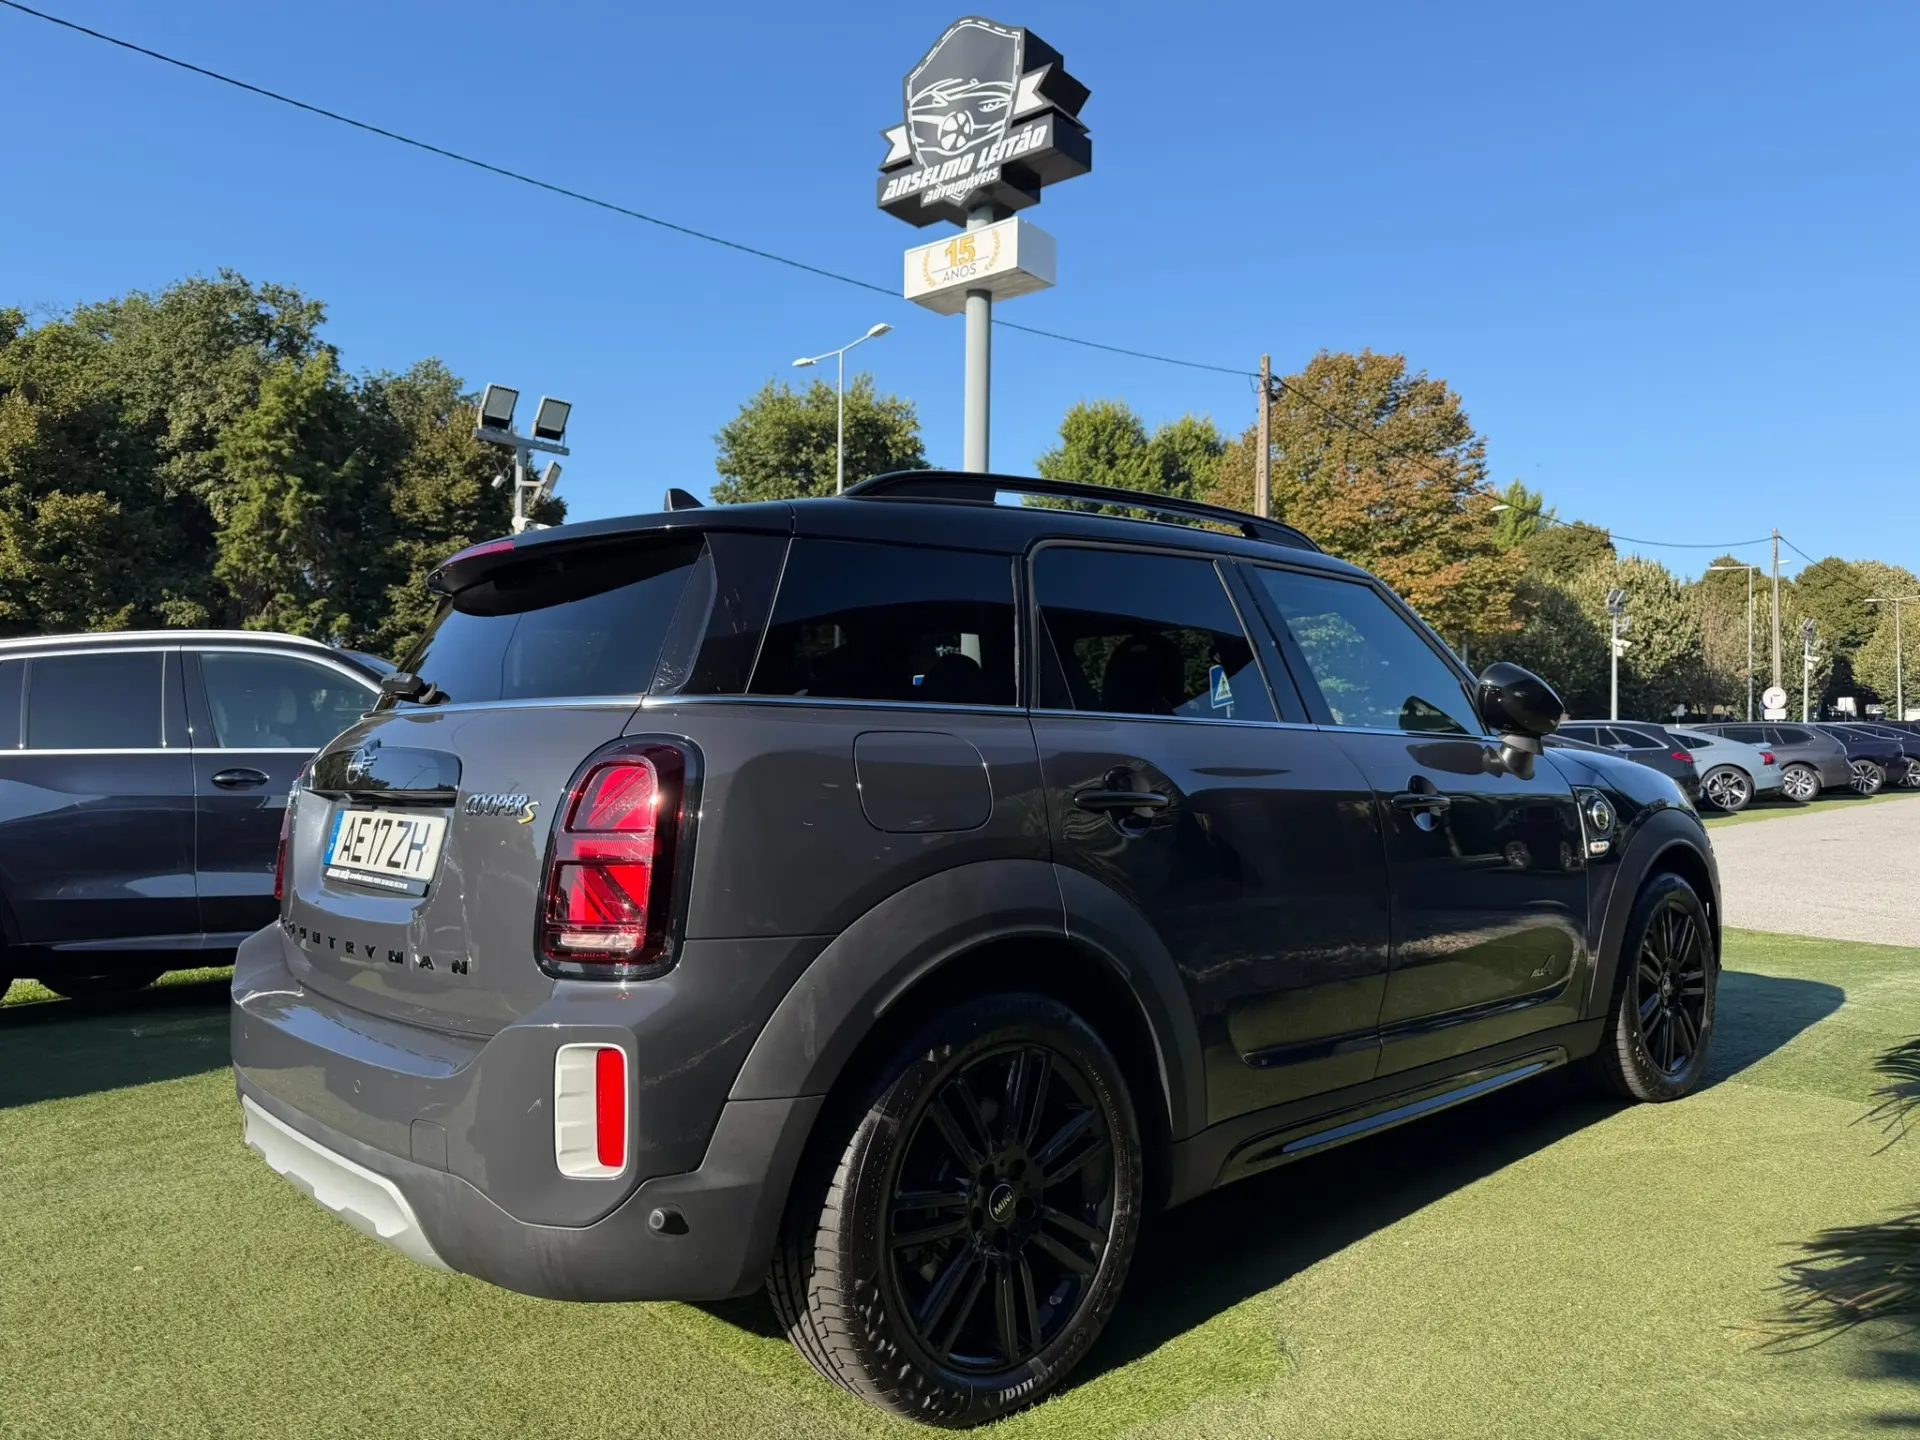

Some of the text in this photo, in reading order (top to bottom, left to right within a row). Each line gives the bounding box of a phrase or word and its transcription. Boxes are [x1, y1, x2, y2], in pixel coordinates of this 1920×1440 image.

[881, 124, 1048, 202] ANSELMO LEITÃO
[944, 235, 976, 268] 15
[942, 262, 977, 283] ANOS
[465, 792, 529, 816] COOPER
[993, 1191, 1013, 1216] MINI
